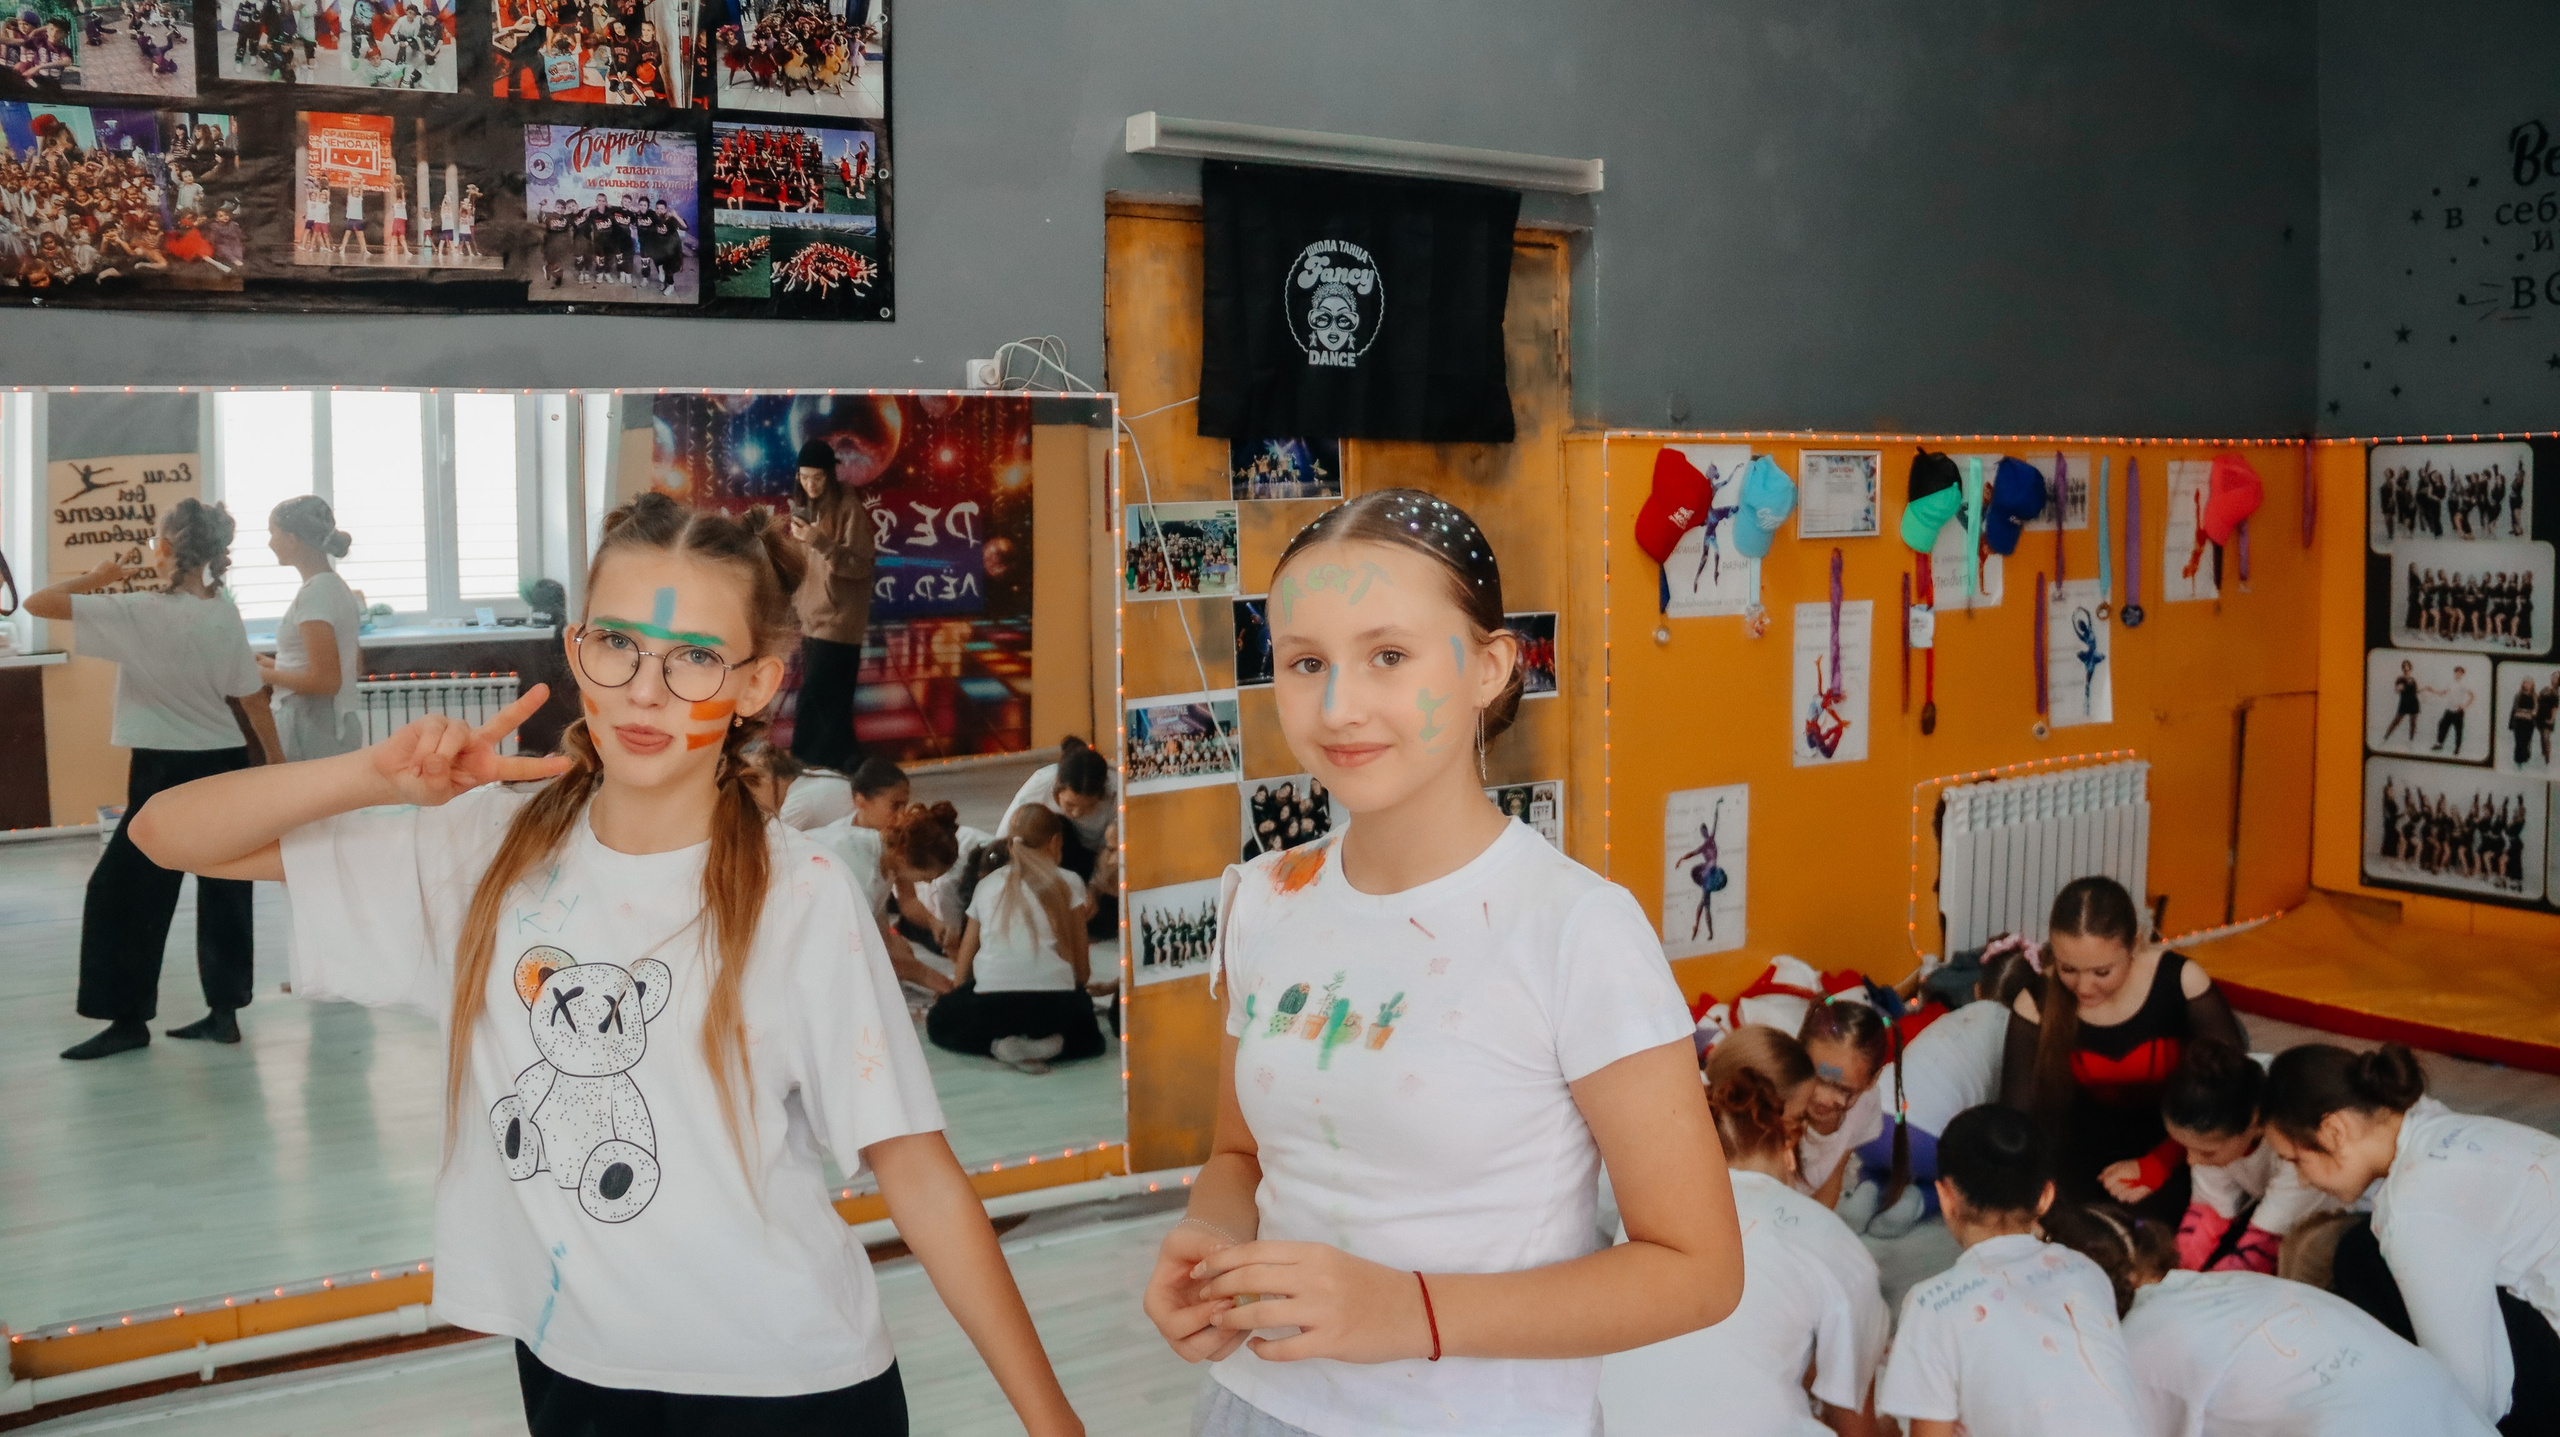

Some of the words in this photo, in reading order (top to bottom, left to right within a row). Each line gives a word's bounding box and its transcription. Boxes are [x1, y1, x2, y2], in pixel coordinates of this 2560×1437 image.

[323, 138, 378, 149] ЧЕМОДАН
[598, 179, 650, 189] сильных
[2495, 191, 2560, 226] себ
[1305, 239, 1338, 258] ШКОЛА
[1339, 240, 1369, 264] ТАНЦА
[1297, 255, 1375, 295] Fancy
[1308, 349, 1357, 367] DANCE
